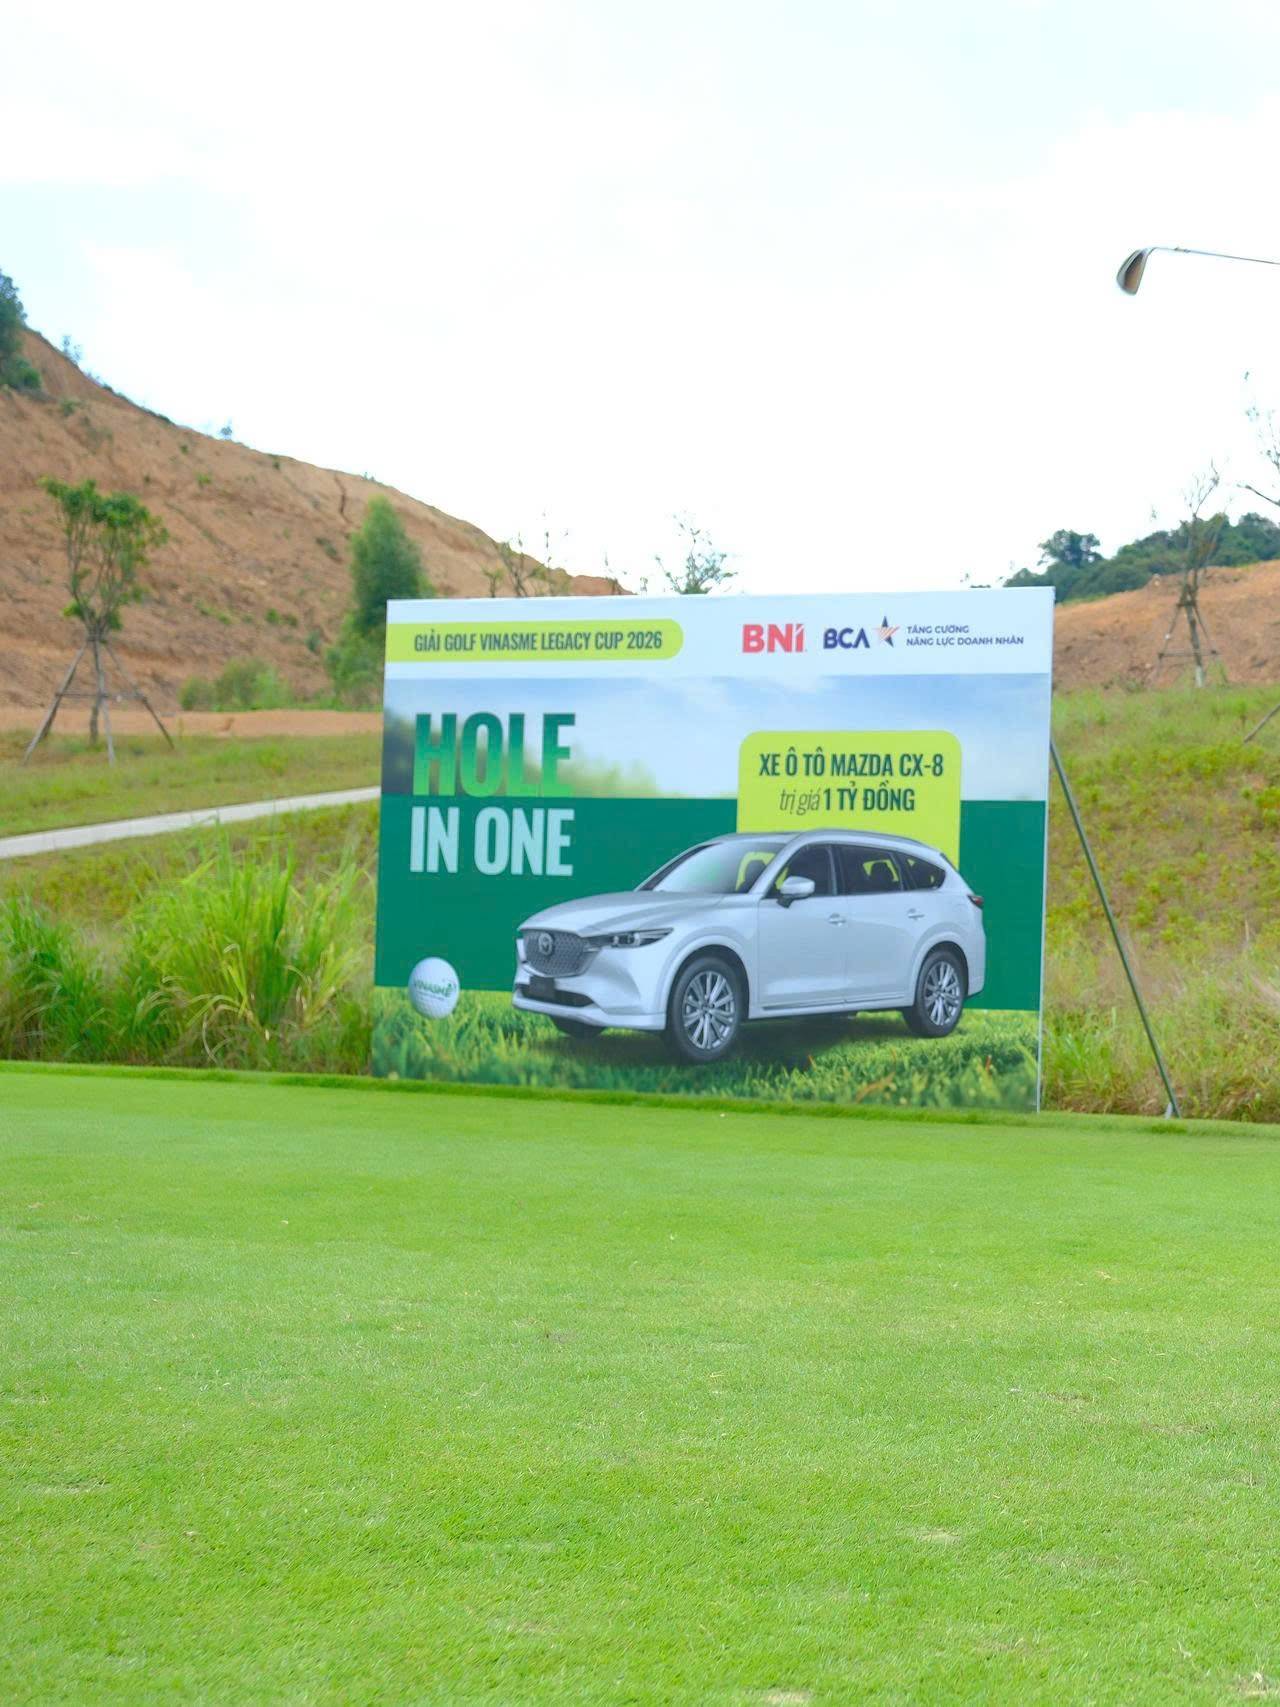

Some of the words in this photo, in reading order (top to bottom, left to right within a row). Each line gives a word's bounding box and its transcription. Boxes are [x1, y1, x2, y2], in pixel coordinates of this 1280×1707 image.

[414, 629, 440, 652] GIẢI
[444, 633, 477, 652] GOLF
[480, 632, 537, 651] VINASME
[541, 631, 591, 650] LEGACY
[595, 631, 624, 649] CUP
[627, 631, 663, 649] 2026
[823, 627, 871, 650] BCA
[906, 636, 934, 646] NĂNG
[936, 636, 956, 647] LỰC
[957, 637, 993, 646] DOANH
[995, 635, 1024, 645] NHÂN
[907, 624, 932, 634] TĂNG
[934, 624, 970, 634] CƯỜNG
[413, 712, 576, 798] HOLE
[759, 753, 781, 776] XE
[785, 746, 798, 776] Ô
[802, 746, 825, 776] TÔ
[830, 753, 893, 776] MAZDA
[900, 753, 944, 776] CX-8
[779, 788, 797, 815] trị
[797, 787, 821, 816] giá
[823, 788, 832, 811] 1
[837, 780, 858, 811] TỶ
[863, 780, 916, 811] ĐỒNG
[410, 806, 460, 873] IN
[474, 806, 575, 876] ONE
